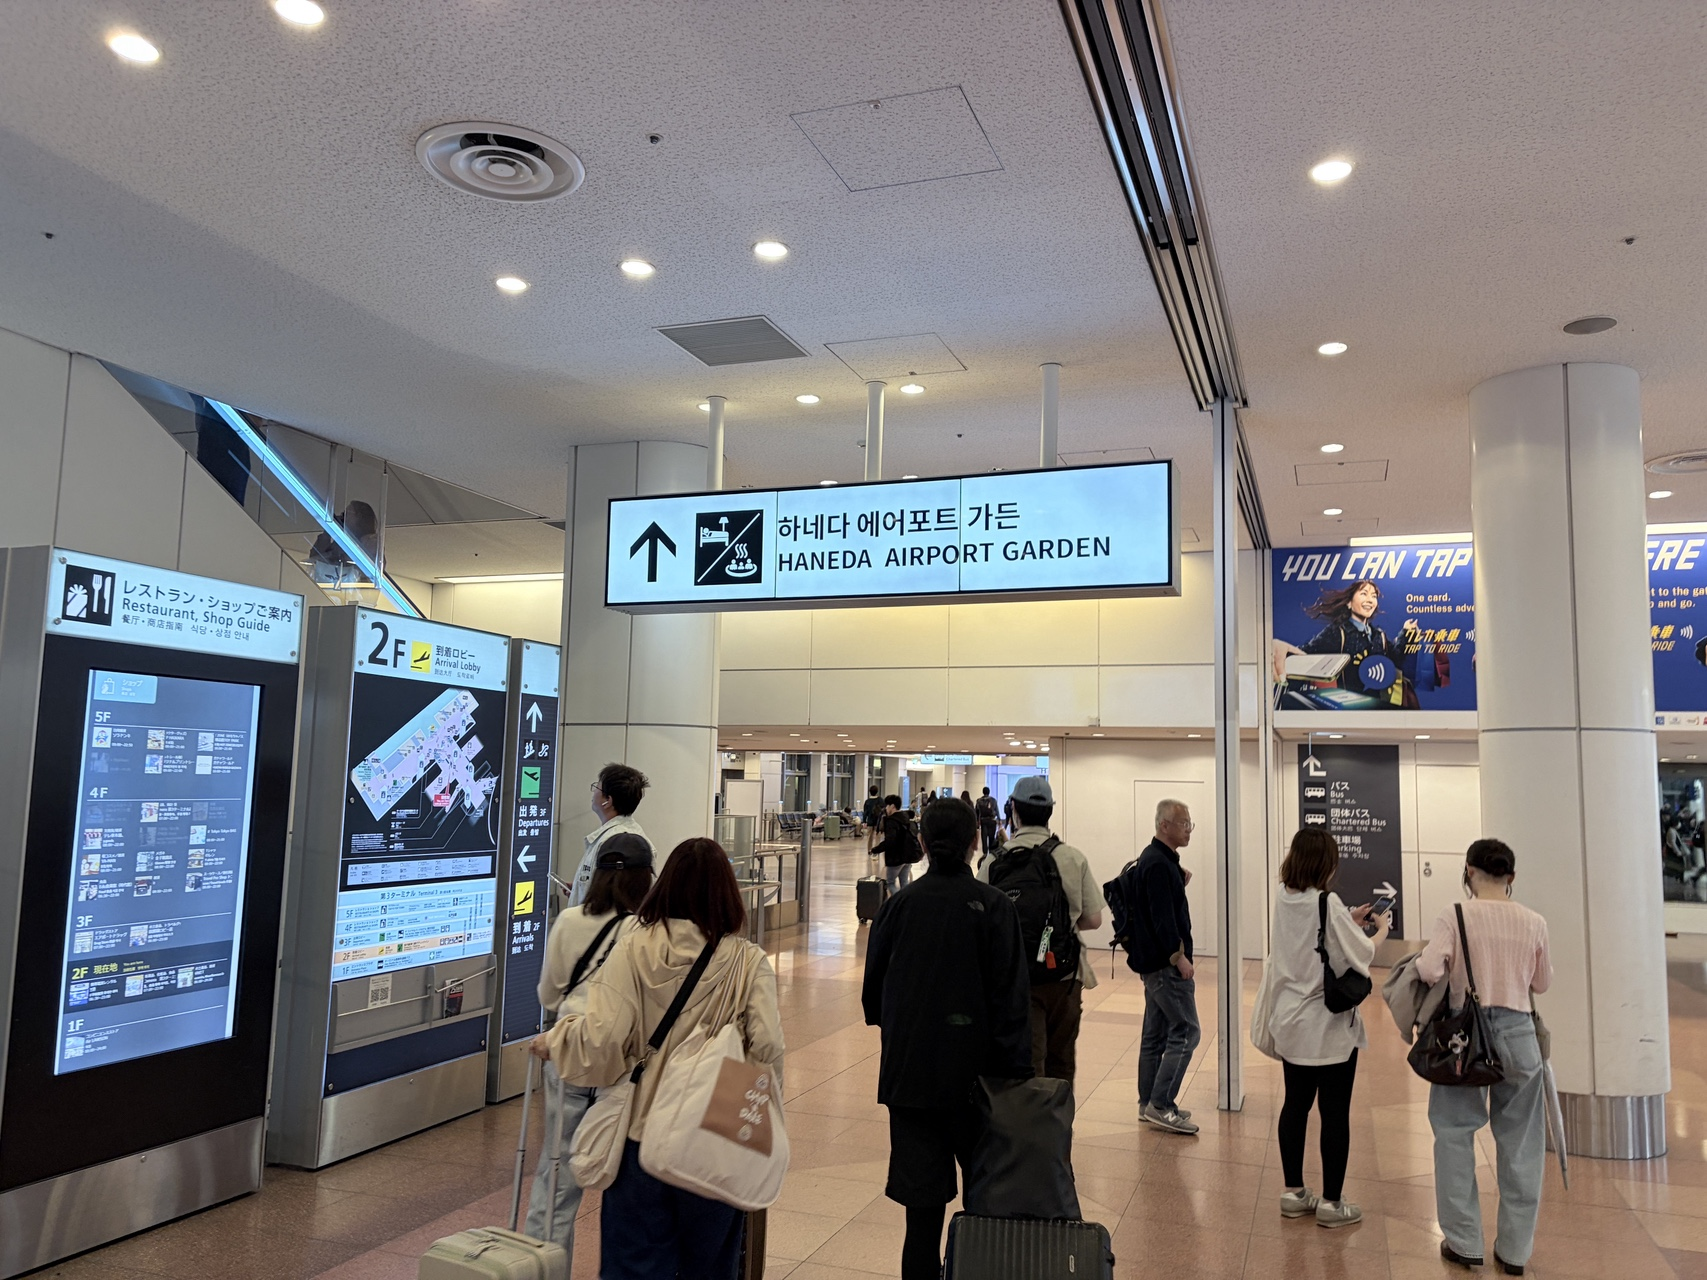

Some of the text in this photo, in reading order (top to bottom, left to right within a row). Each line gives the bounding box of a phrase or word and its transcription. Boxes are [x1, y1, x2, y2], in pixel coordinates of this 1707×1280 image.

[778, 502, 1020, 542] 하네다 에어포트 가든
[778, 536, 1111, 572] HANEDA AIRPORT GARDEN
[1282, 547, 1473, 581] YOU CAN TAP
[1658, 587, 1669, 597] to
[1672, 586, 1689, 597] the
[123, 580, 292, 623] レストラン・ショップご案内
[1405, 593, 1425, 603] One
[1657, 598, 1676, 609] and
[1406, 604, 1452, 613] Countless
[122, 598, 271, 633] Restaurant, Shop Guide
[367, 621, 406, 669] 2F
[1404, 643, 1461, 654] TAP TO RIDE
[1651, 640, 1676, 651] RIDE
[435, 645, 475, 660] 到着ロビー
[435, 657, 481, 674] Arrival Lobby
[94, 711, 112, 723] 5F
[1330, 781, 1350, 791] バス
[89, 787, 109, 799] 4F
[1330, 790, 1344, 798] Bus
[540, 808, 547, 817] 3F
[1330, 808, 1370, 818] 団体バス
[518, 819, 549, 829] Departures
[1330, 818, 1386, 826] Chartered Bus
[380, 890, 416, 900] 第3ターミナル
[346, 909, 354, 918] 5F
[76, 915, 93, 928] 3F
[533, 922, 540, 931] 2F
[344, 923, 353, 932] 4F
[343, 937, 352, 947] 3F
[512, 932, 534, 945] Arrivals
[342, 952, 350, 961] 2F
[71, 967, 89, 980] 2F
[93, 962, 118, 975] 現在地
[342, 966, 349, 975] 1F
[67, 1019, 85, 1032] 1F
